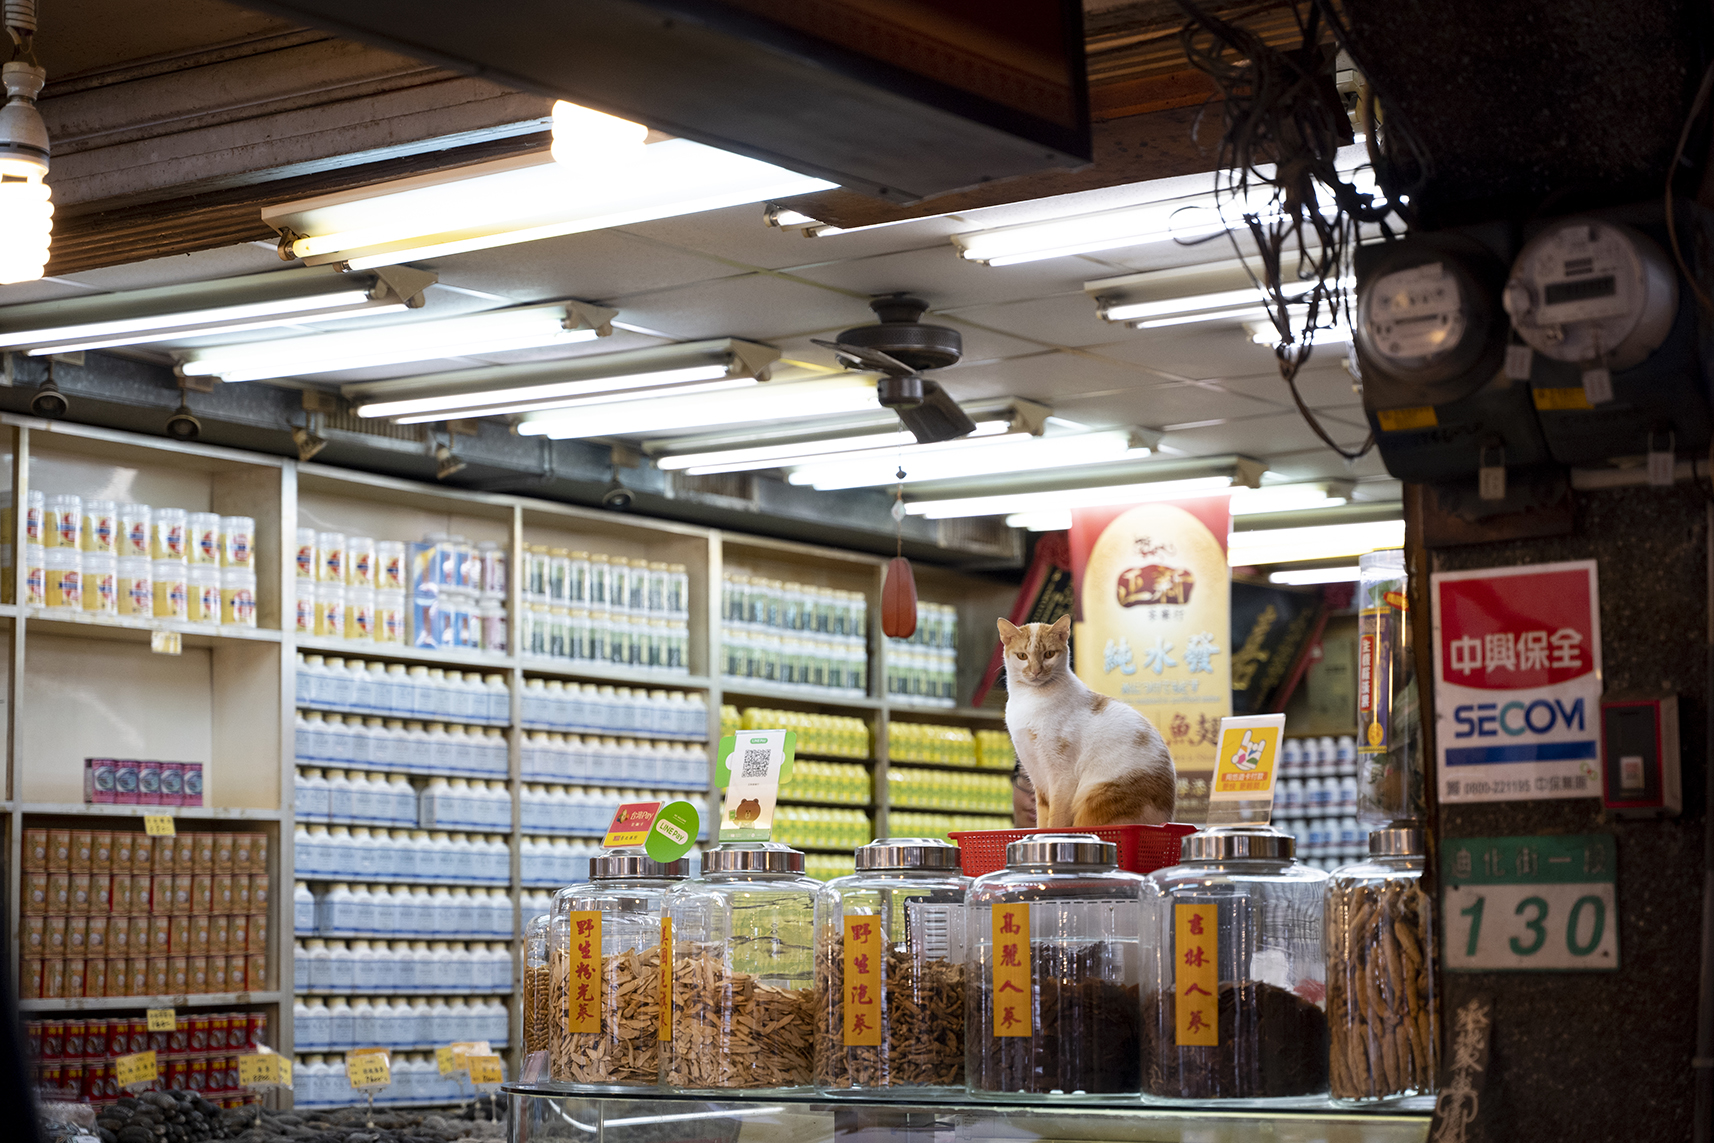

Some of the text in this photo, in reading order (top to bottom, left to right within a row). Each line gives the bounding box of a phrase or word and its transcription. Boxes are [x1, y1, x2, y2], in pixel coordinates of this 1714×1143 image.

[1103, 630, 1220, 675] 純水發
[1450, 627, 1584, 676] 中興保全
[1454, 697, 1585, 739] SECOM
[659, 822, 685, 842] LINE Pay
[1460, 895, 1607, 957] 130
